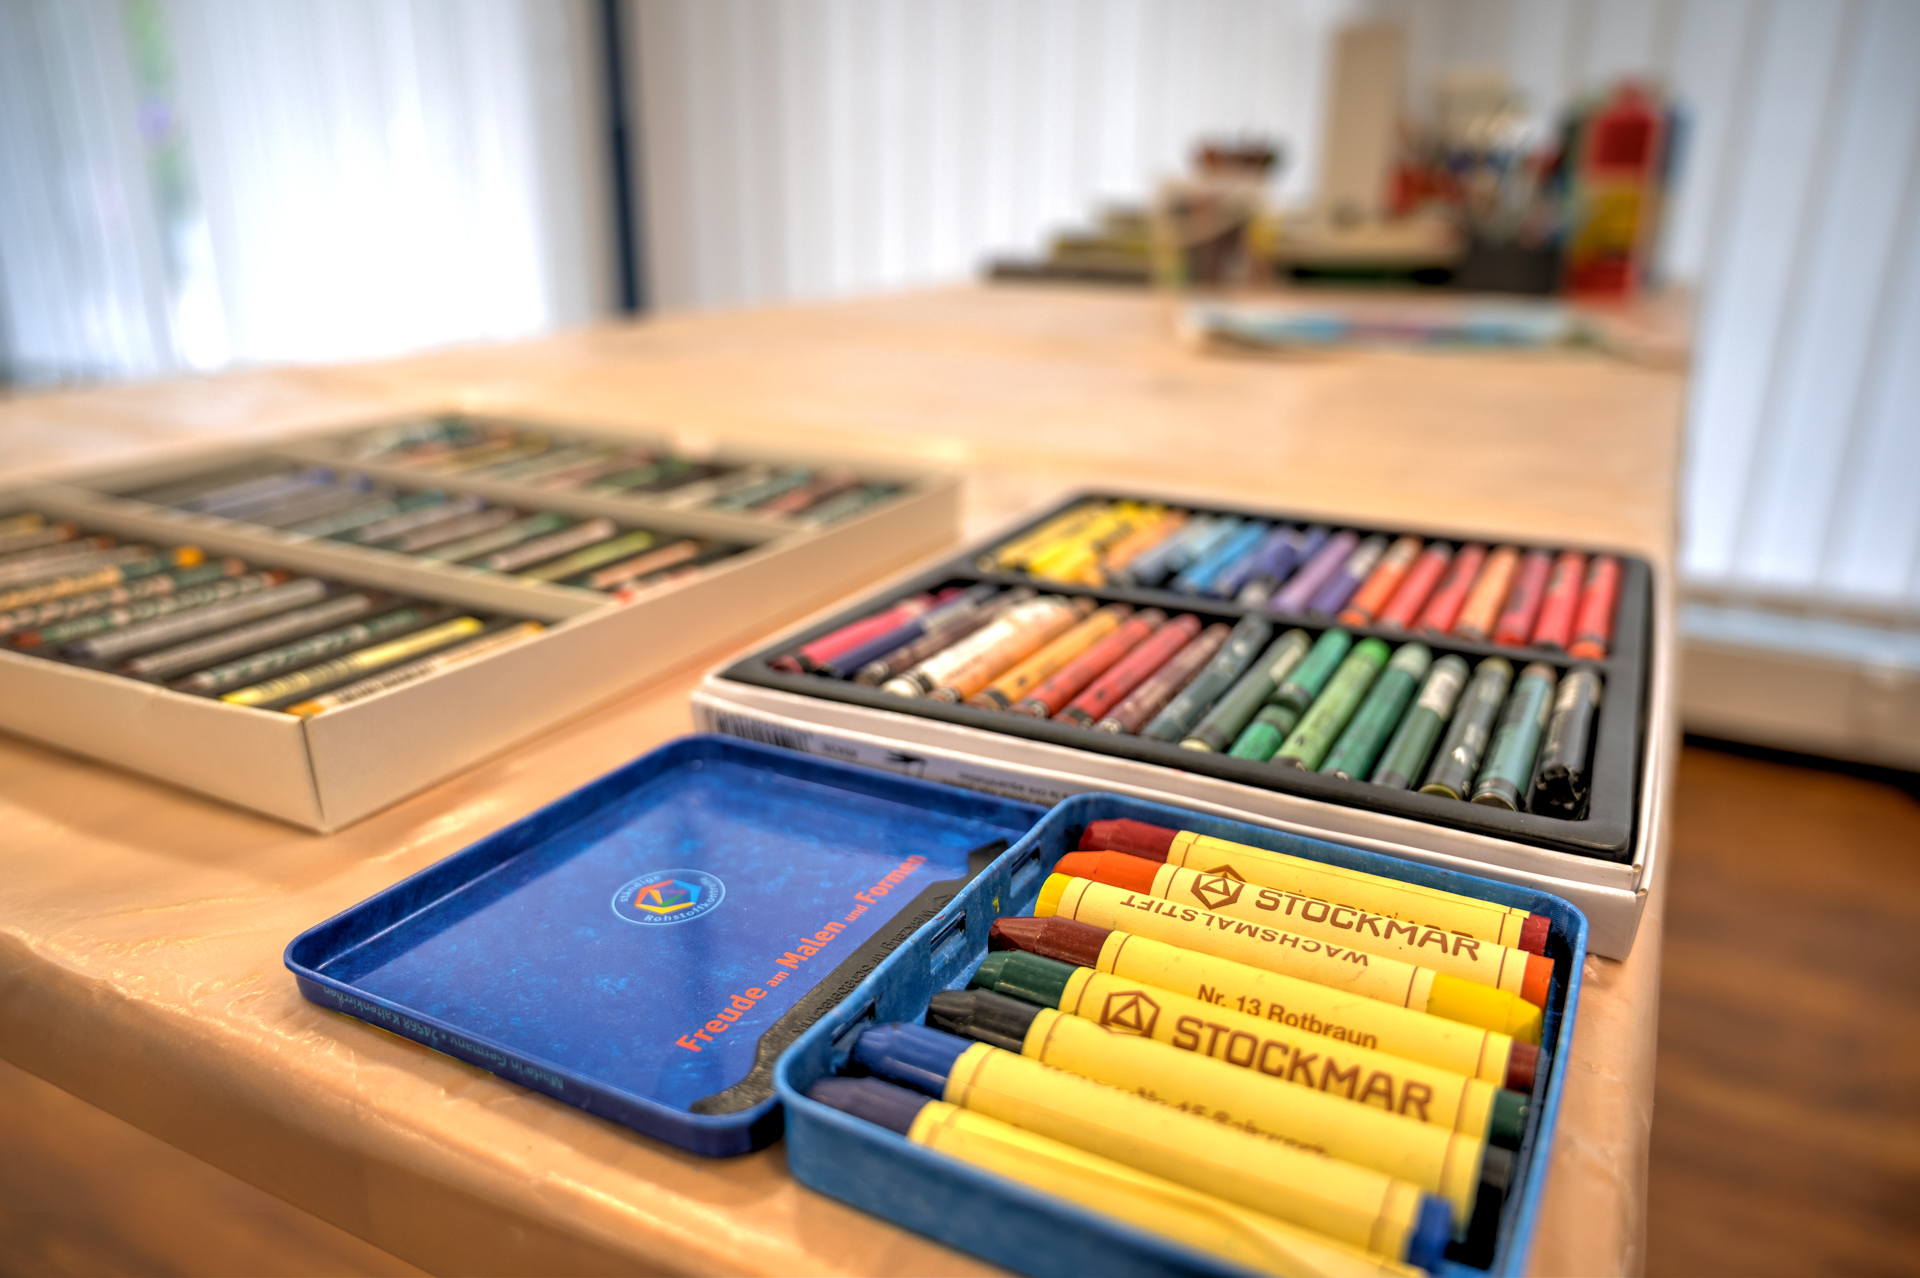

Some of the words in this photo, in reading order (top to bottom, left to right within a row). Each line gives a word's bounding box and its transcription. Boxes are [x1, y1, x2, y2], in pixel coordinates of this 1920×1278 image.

[854, 853, 929, 905] Formen
[775, 921, 847, 970] Malen
[845, 903, 869, 923] und
[1120, 894, 1370, 967] WACHSMALSTIFT
[1254, 889, 1482, 962] STOCKMAR
[766, 970, 790, 988] am
[676, 986, 768, 1052] Freude
[1197, 984, 1227, 1008] Nr.
[1236, 995, 1262, 1017] 13
[1267, 1003, 1378, 1050] Rotbraun
[1171, 1015, 1434, 1122] STOCKMAR
